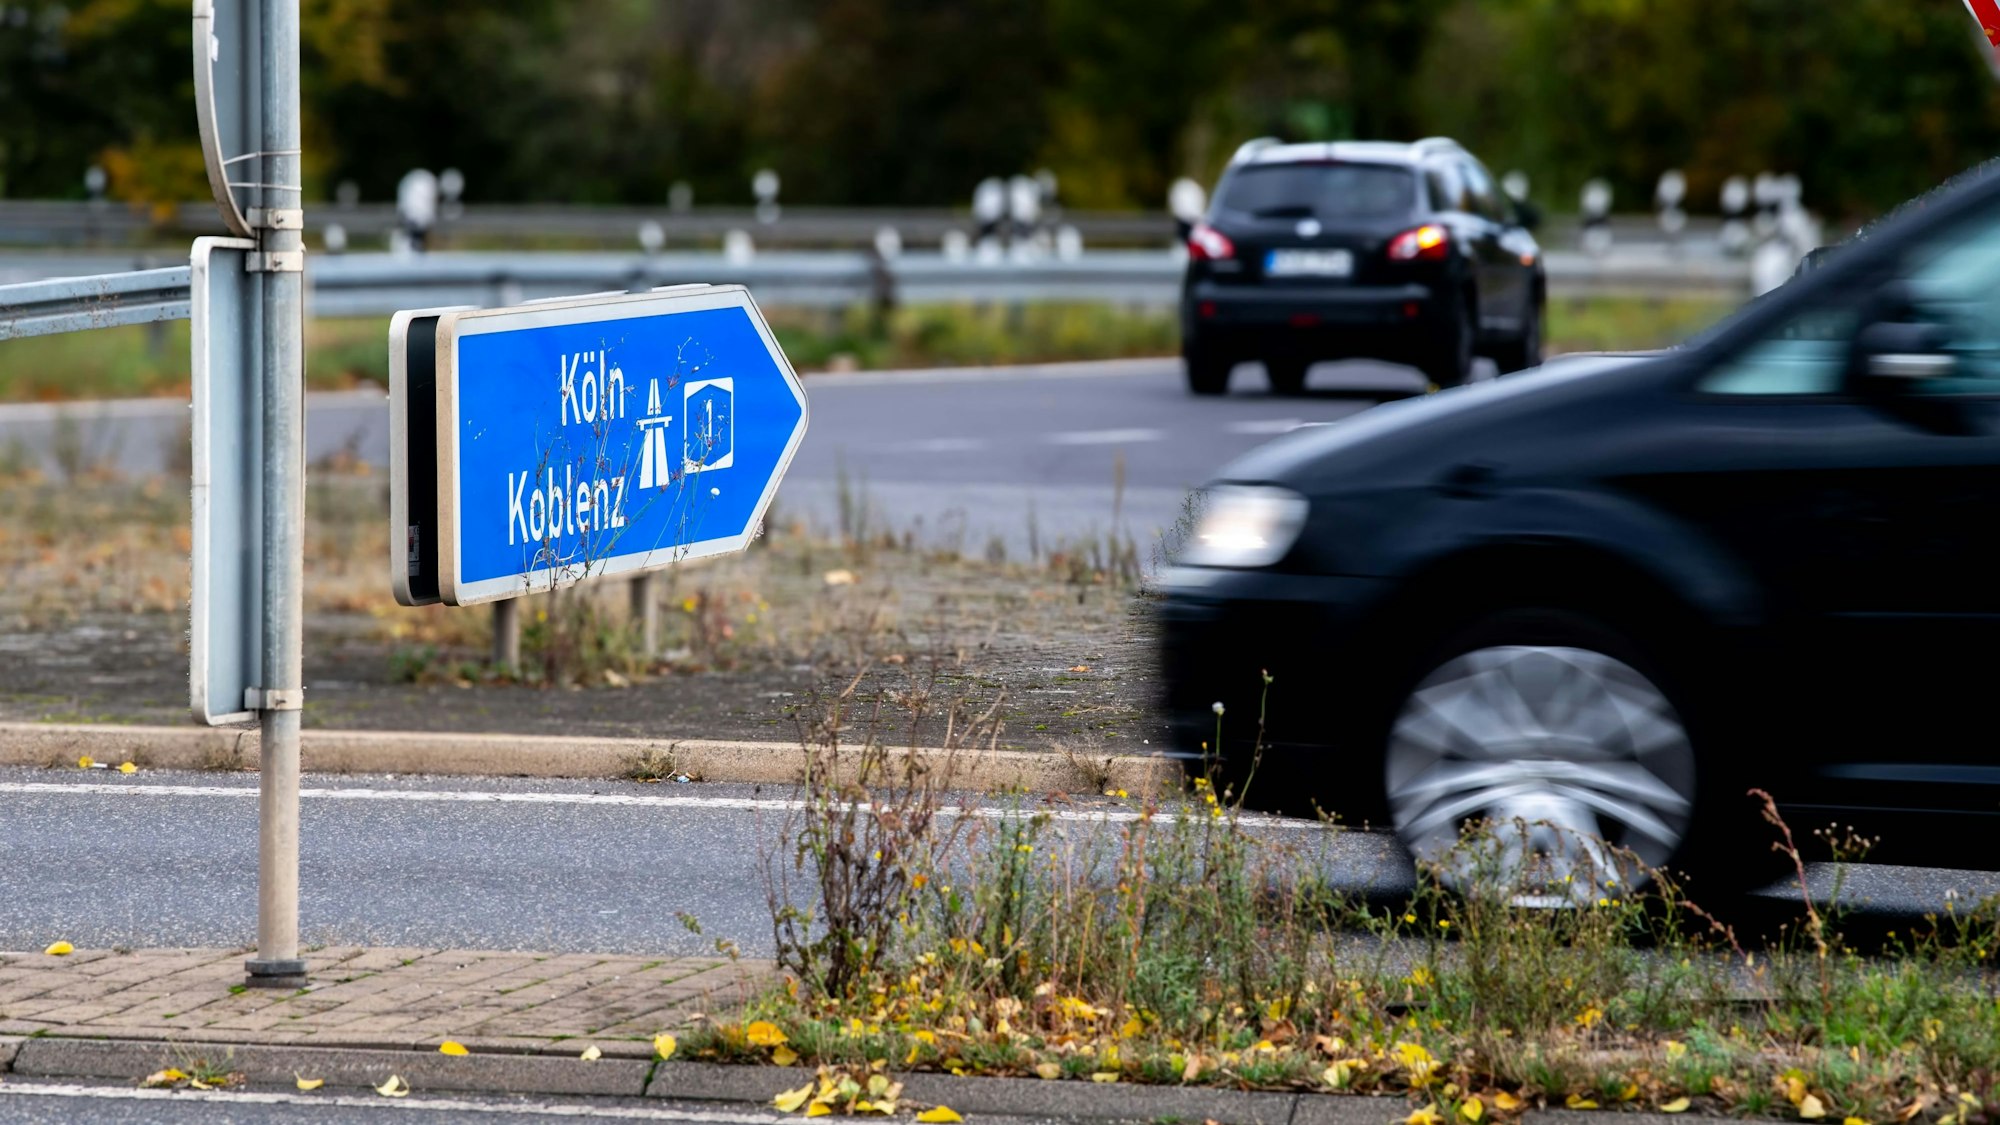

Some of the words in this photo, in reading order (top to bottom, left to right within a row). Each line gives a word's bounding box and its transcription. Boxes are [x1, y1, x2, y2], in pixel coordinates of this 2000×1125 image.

[561, 350, 624, 426] Köln
[705, 398, 713, 448] 1
[508, 464, 625, 545] Koblenz
